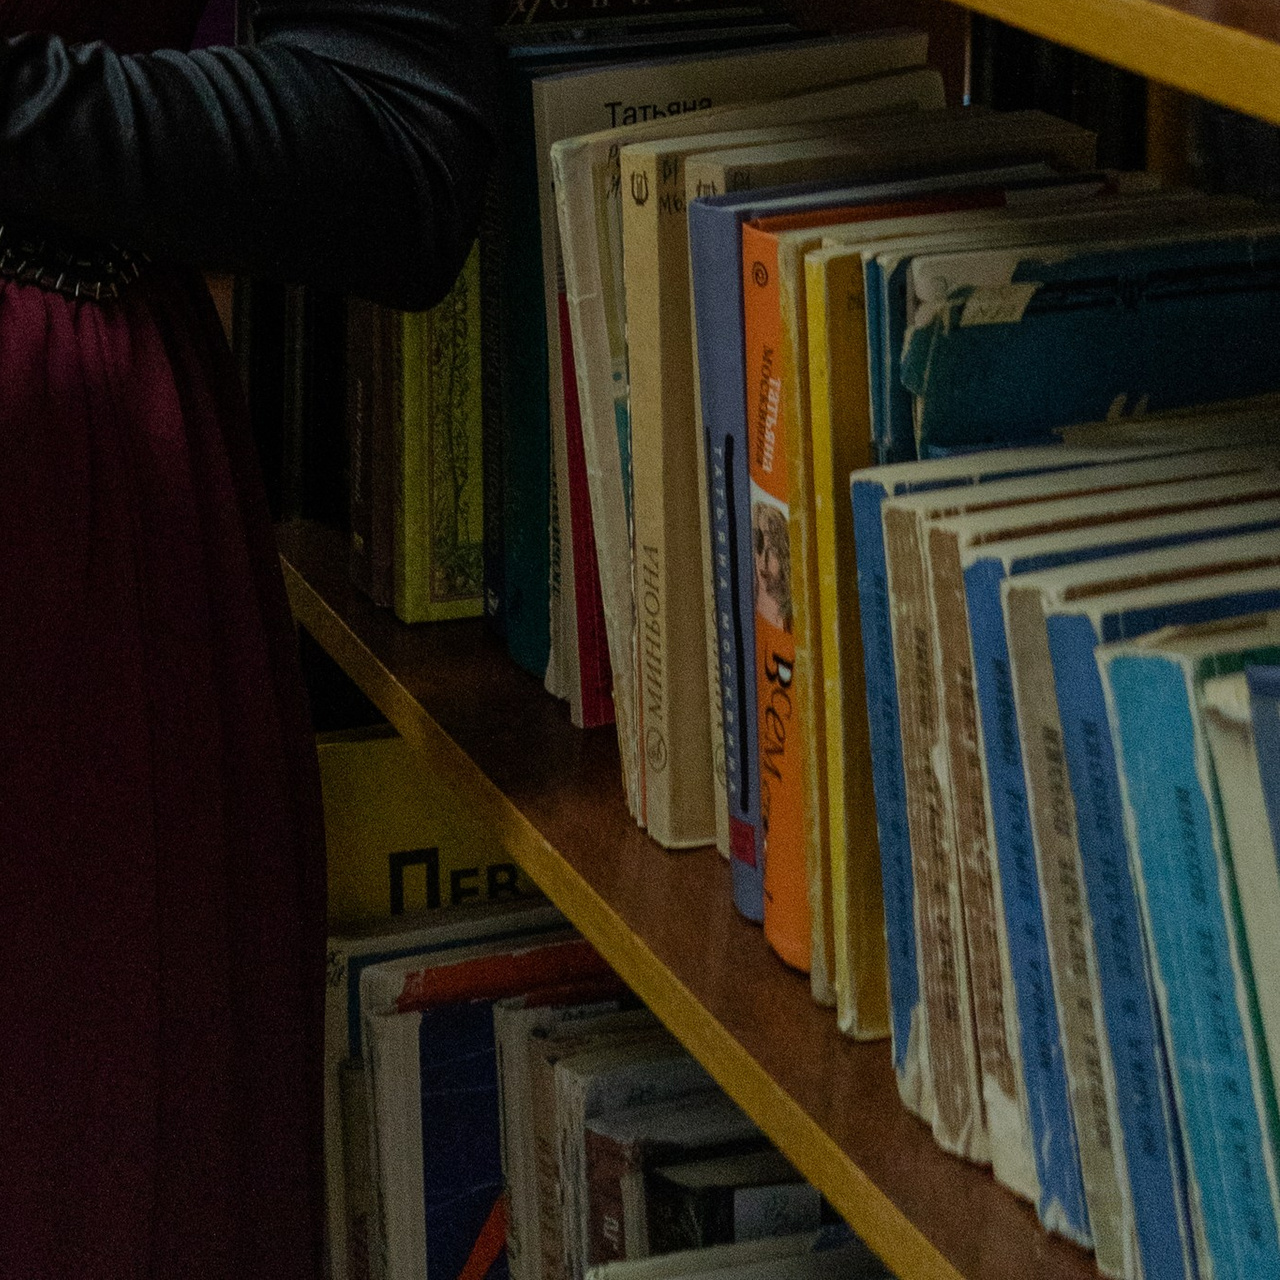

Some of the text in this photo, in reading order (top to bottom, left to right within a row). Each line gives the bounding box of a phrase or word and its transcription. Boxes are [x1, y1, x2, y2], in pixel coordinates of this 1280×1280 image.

[603, 96, 713, 129] Татьяна
[713, 446, 730, 589] ТАТЬЯНА
[643, 544, 664, 722] МИНЬОНА
[720, 613, 739, 796] МОСКВИНА
